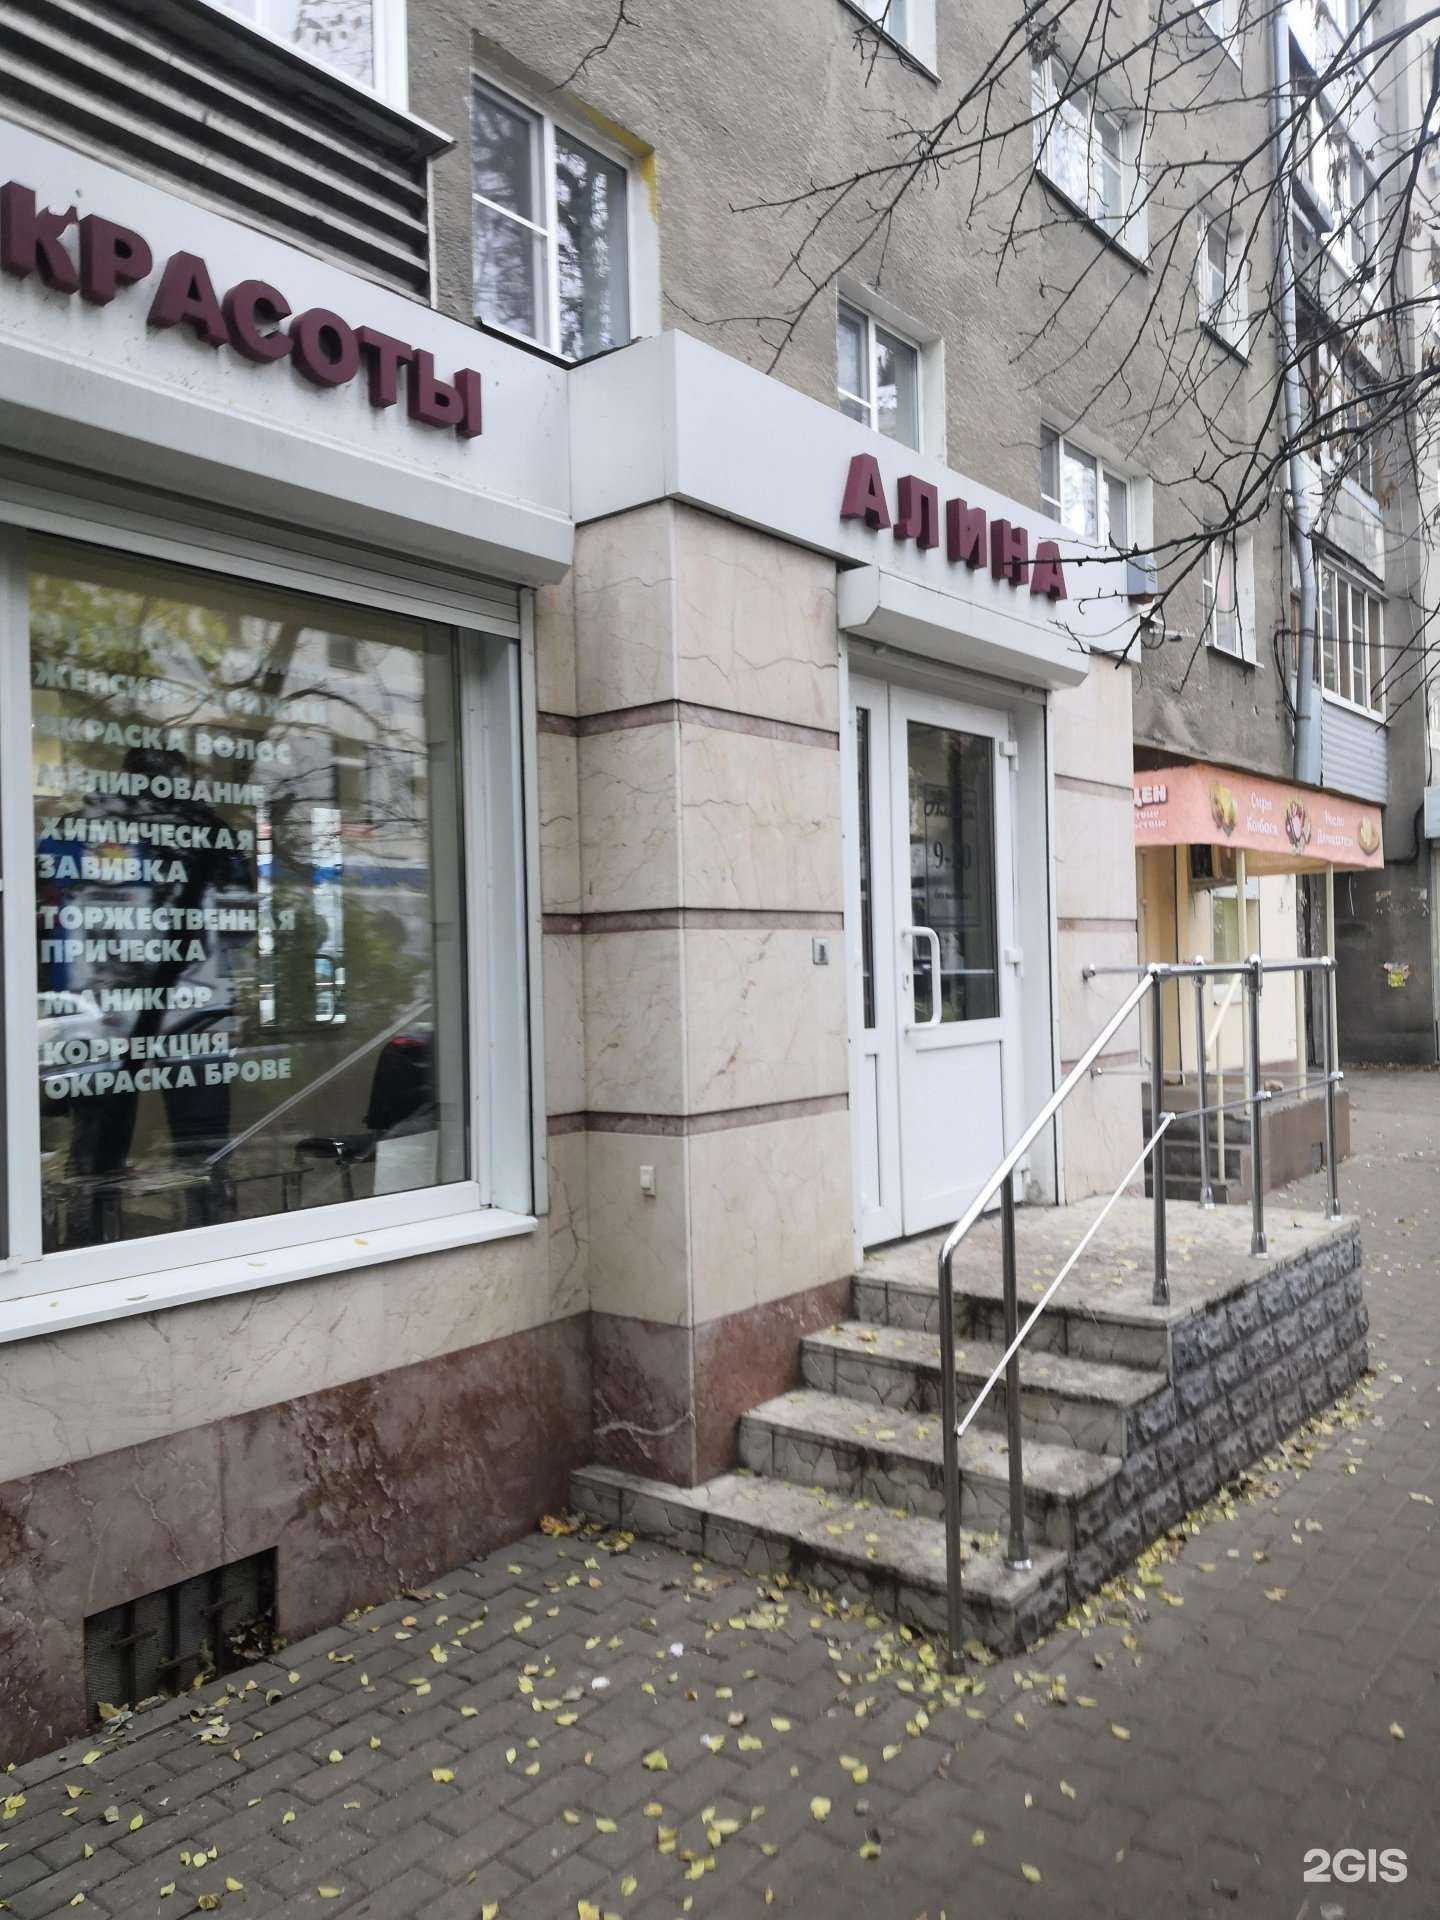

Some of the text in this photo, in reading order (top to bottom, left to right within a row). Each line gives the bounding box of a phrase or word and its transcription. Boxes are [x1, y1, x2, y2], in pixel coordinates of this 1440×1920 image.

[0, 180, 482, 439] КРАСОТЫ
[840, 452, 1069, 601] АЛИНА
[35, 662, 187, 703] ЖЕНСК
[195, 732, 292, 765] ВОЛОС
[37, 764, 265, 807] МЕЛИРОВАНИЕ
[40, 816, 254, 850] ХИМИЧЕСКАЯ
[38, 854, 189, 883] ЗАВИВКА
[38, 904, 296, 931] ТОРЖЕСТВЕННАЯ
[40, 938, 207, 963] ПРИЧЕСКА
[43, 985, 213, 1015] МАНИКЮР
[42, 1031, 237, 1066] КОРРЕКЦИЯ,
[44, 1057, 292, 1100] ОКРАСКА БРОВЕ
